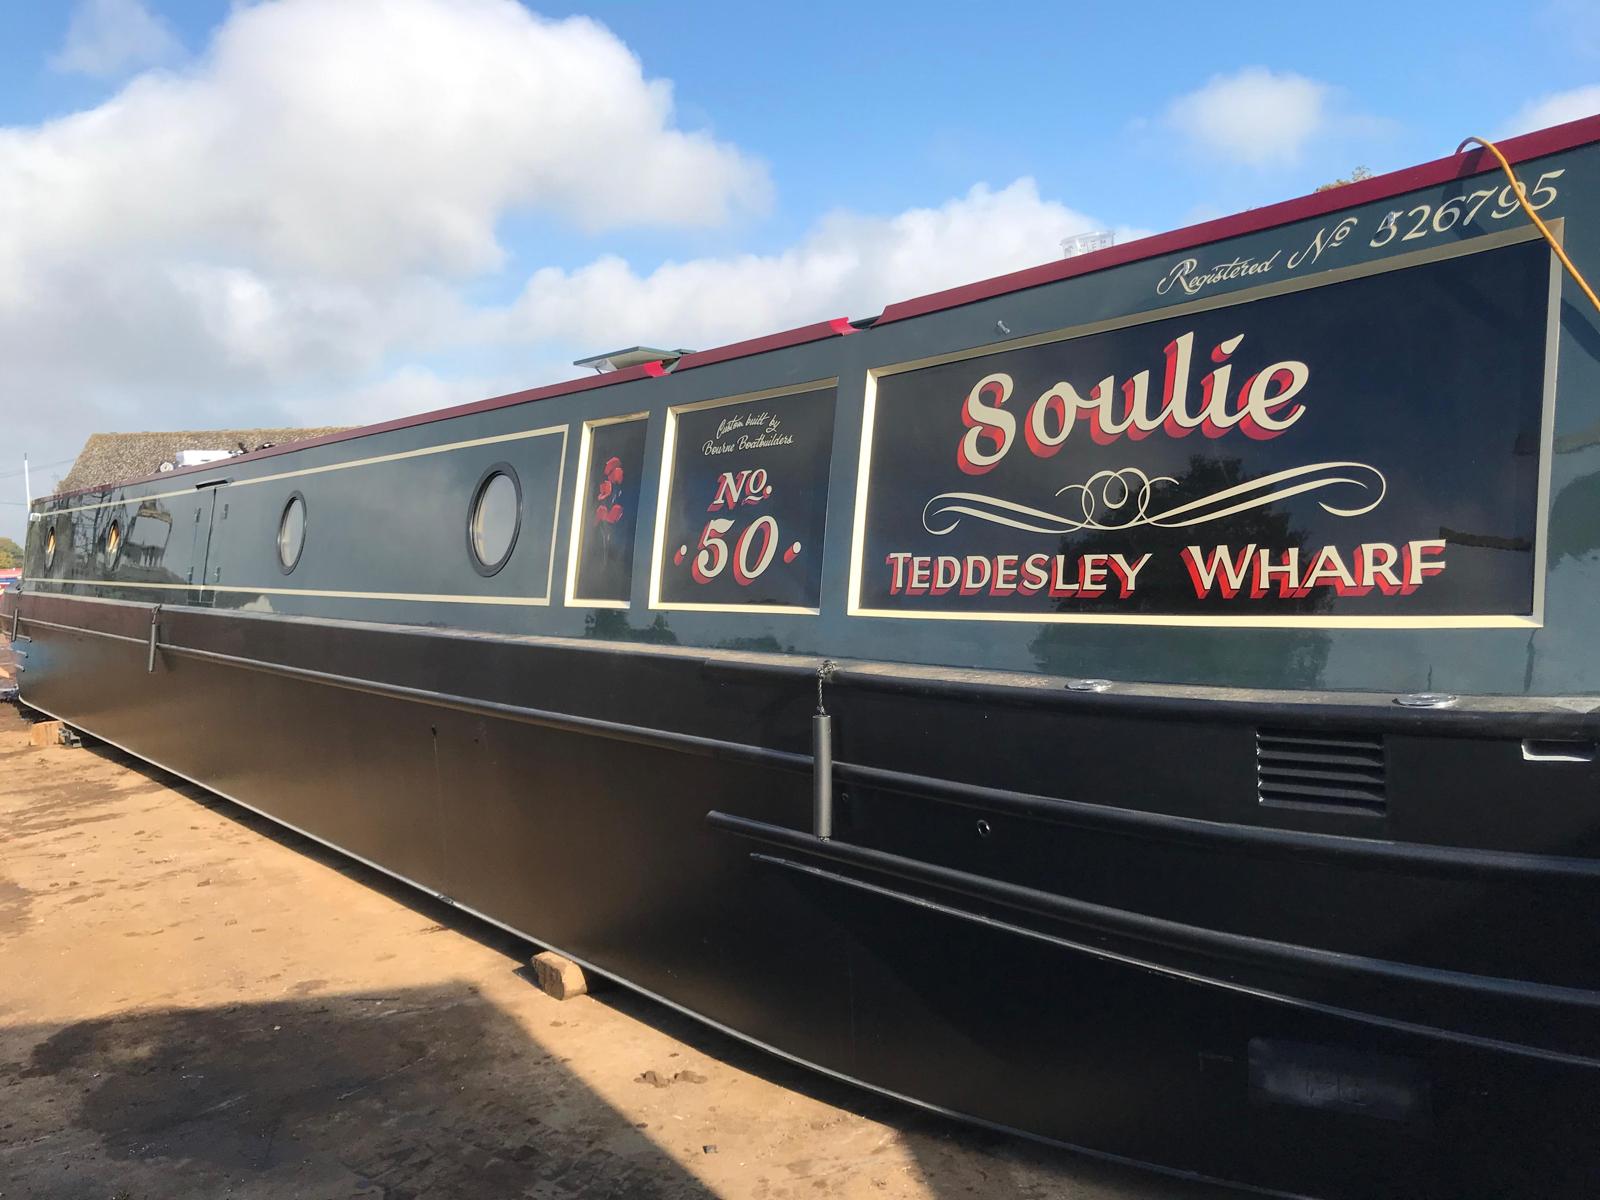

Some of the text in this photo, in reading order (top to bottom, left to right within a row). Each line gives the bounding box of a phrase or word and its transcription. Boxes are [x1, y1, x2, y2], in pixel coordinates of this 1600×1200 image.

[1156, 249, 1282, 295] Registered
[1368, 168, 1566, 248] 526795
[716, 412, 781, 440] Custom built by
[956, 331, 1310, 475] Soulie
[702, 433, 795, 455] Bourne Boatbuilders
[886, 538, 1448, 599] TEDDESLEY WHARF
